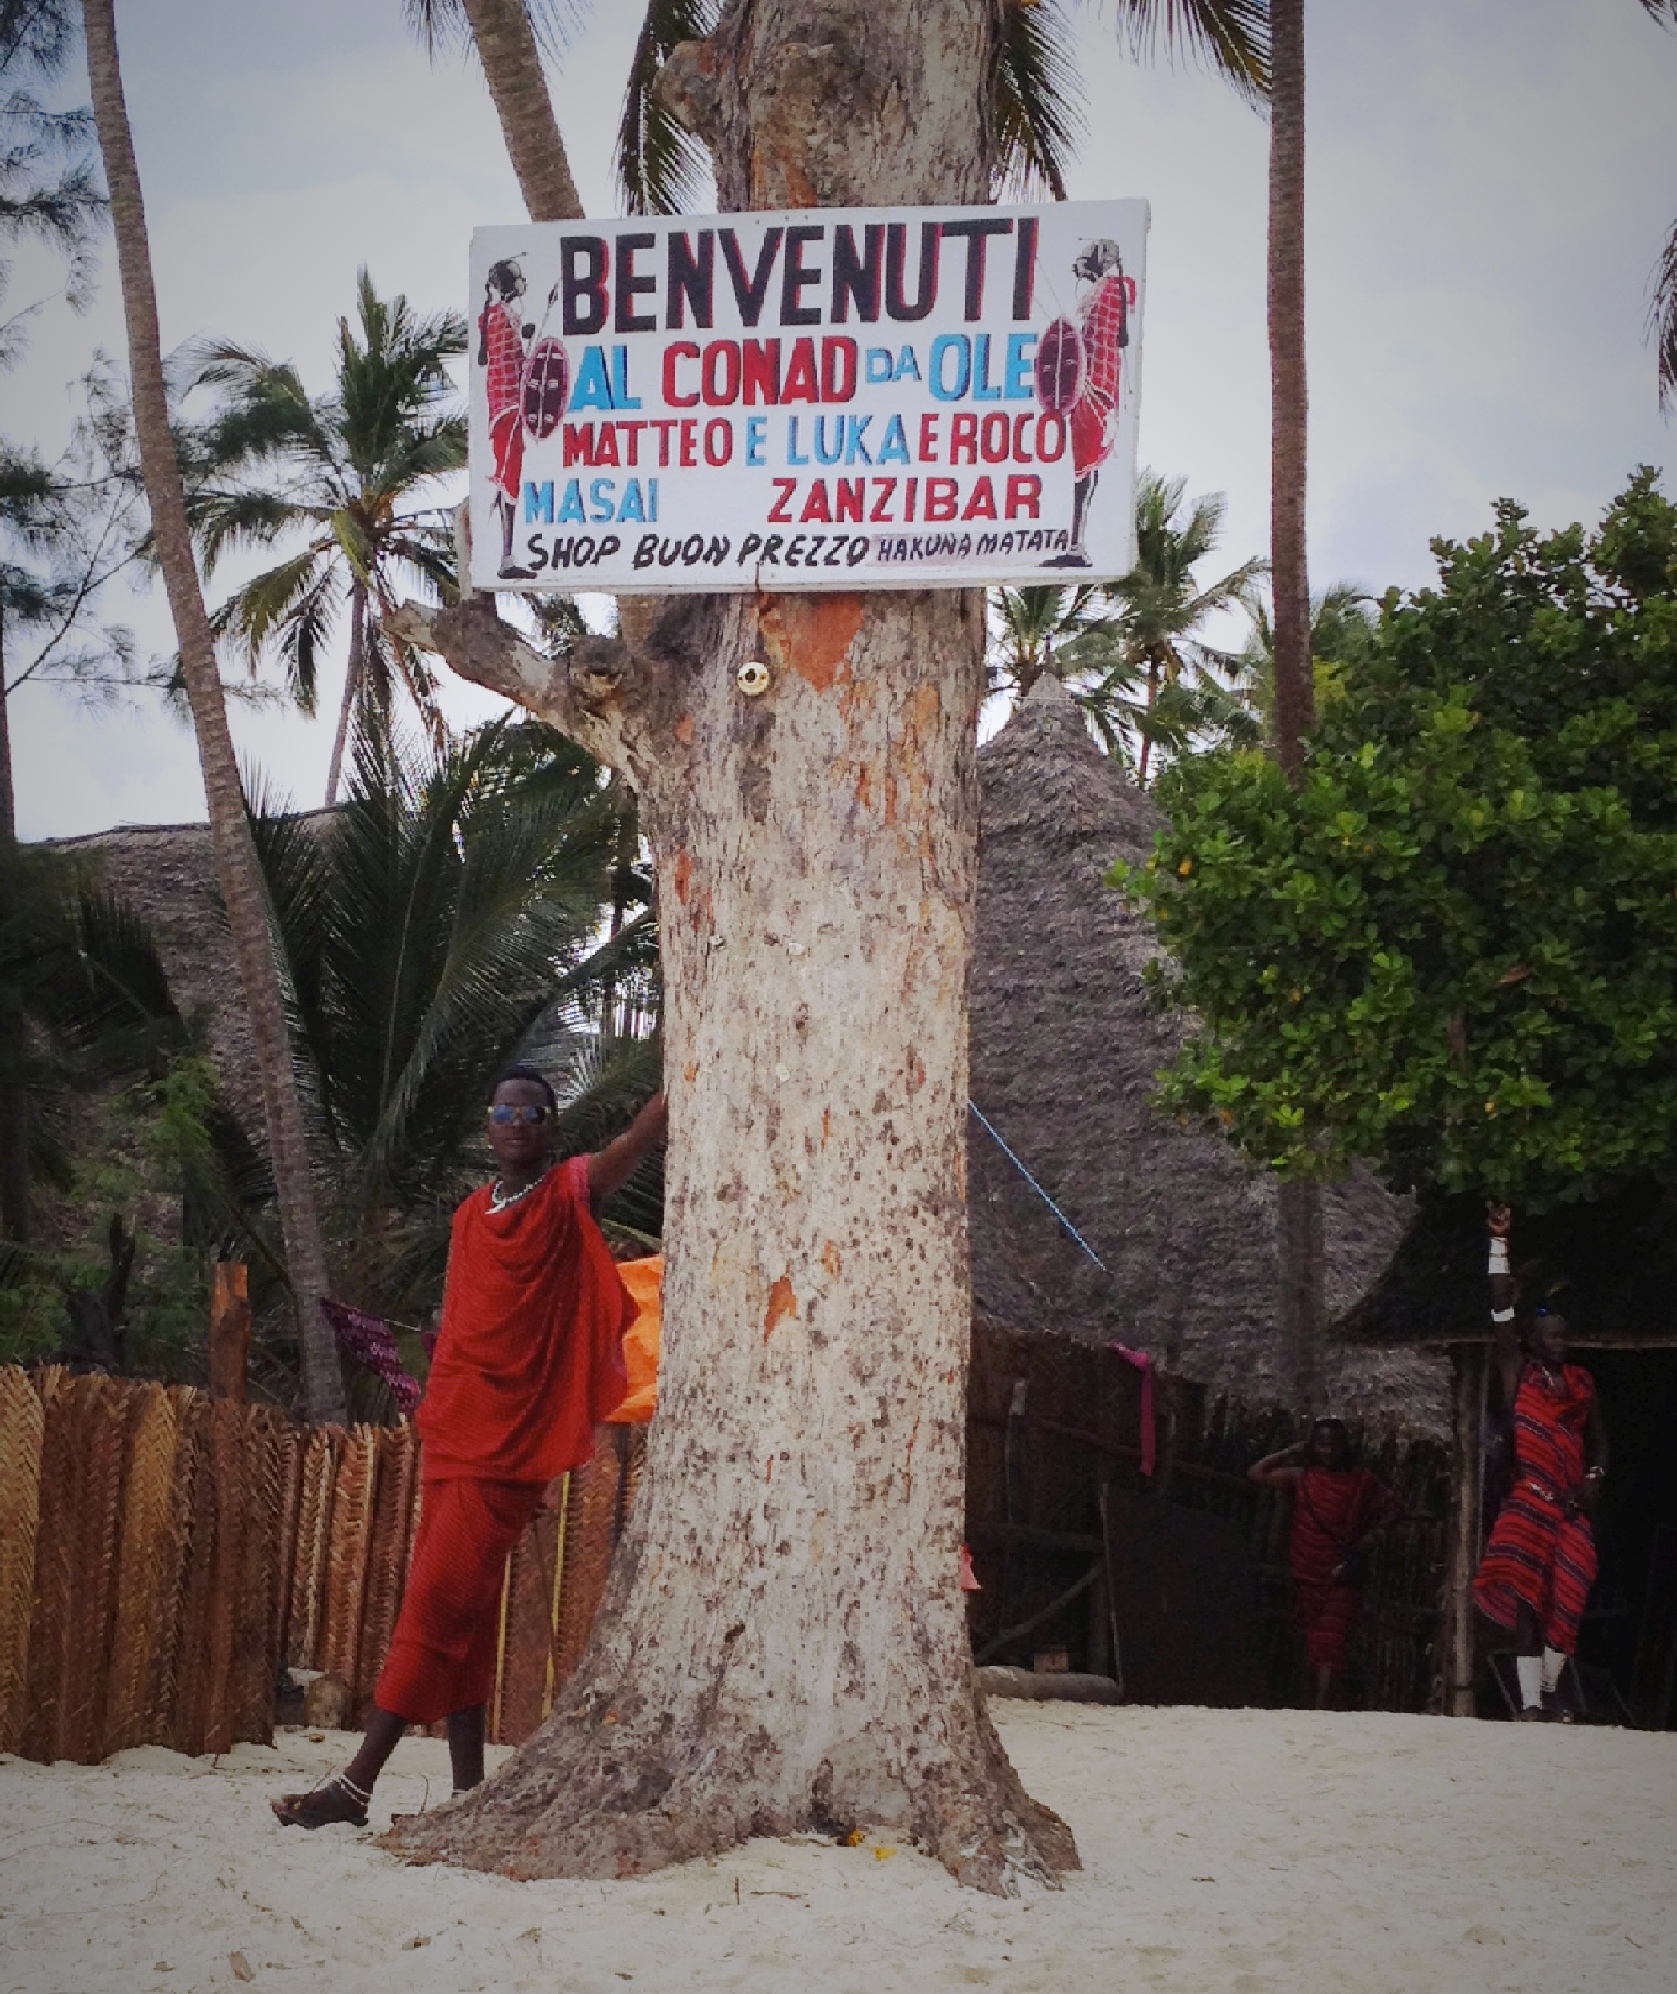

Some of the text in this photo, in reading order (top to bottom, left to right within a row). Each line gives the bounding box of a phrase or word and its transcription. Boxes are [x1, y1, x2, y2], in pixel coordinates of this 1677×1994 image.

[560, 217, 1038, 335] BENVENUTI
[568, 332, 1038, 410] AL CONAD DA OLE
[562, 412, 1065, 468] MATTEO E LUKA E ROCO
[524, 474, 1043, 523] MASAI ZANZIBAR
[526, 529, 1069, 571] SHOP BUON PREZZO HAKUNA MATATA
